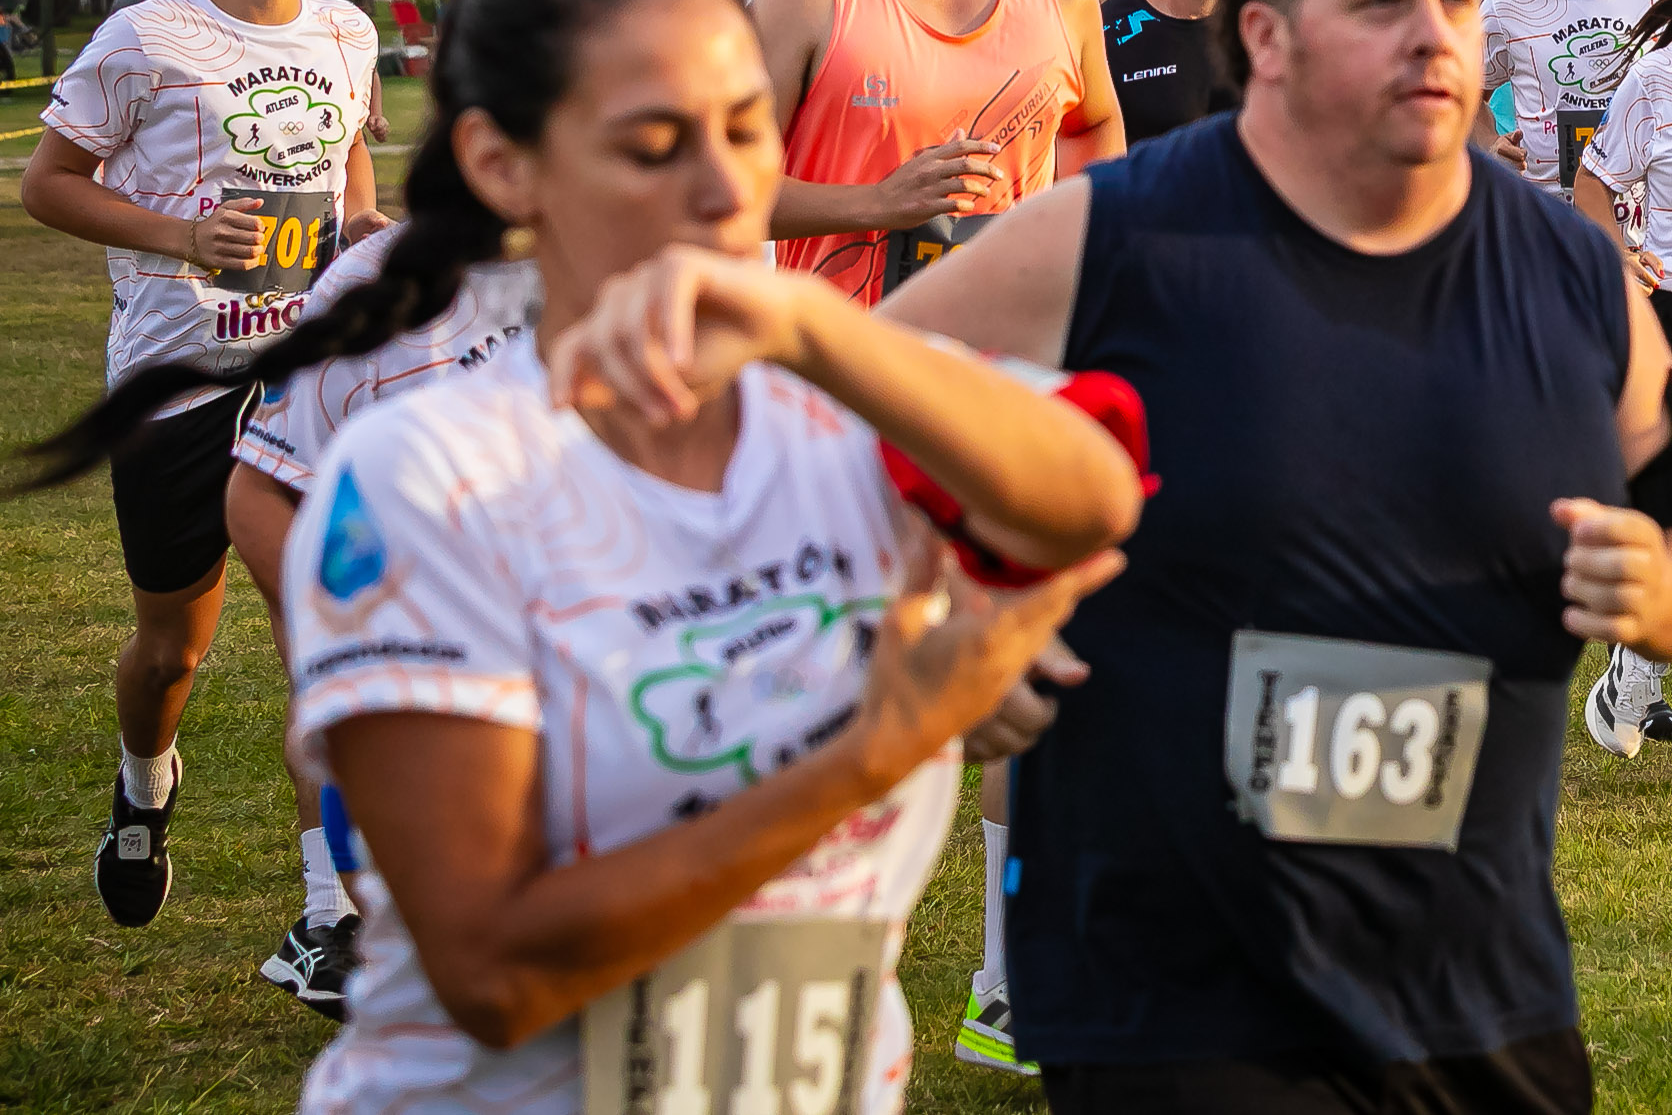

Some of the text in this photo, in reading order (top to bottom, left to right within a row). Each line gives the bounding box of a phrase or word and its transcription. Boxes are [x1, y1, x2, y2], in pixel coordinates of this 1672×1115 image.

[1578, 38, 1609, 56] ATLETAS
[227, 65, 333, 98] MARATÓN
[1123, 64, 1177, 82] LENING
[266, 94, 299, 115] ATLETAS
[276, 141, 316, 161] EL TREBOL
[235, 158, 333, 187] ANIVERSARIO
[256, 214, 321, 271] 701
[1277, 684, 1442, 806] 163
[659, 977, 848, 1115] 115
